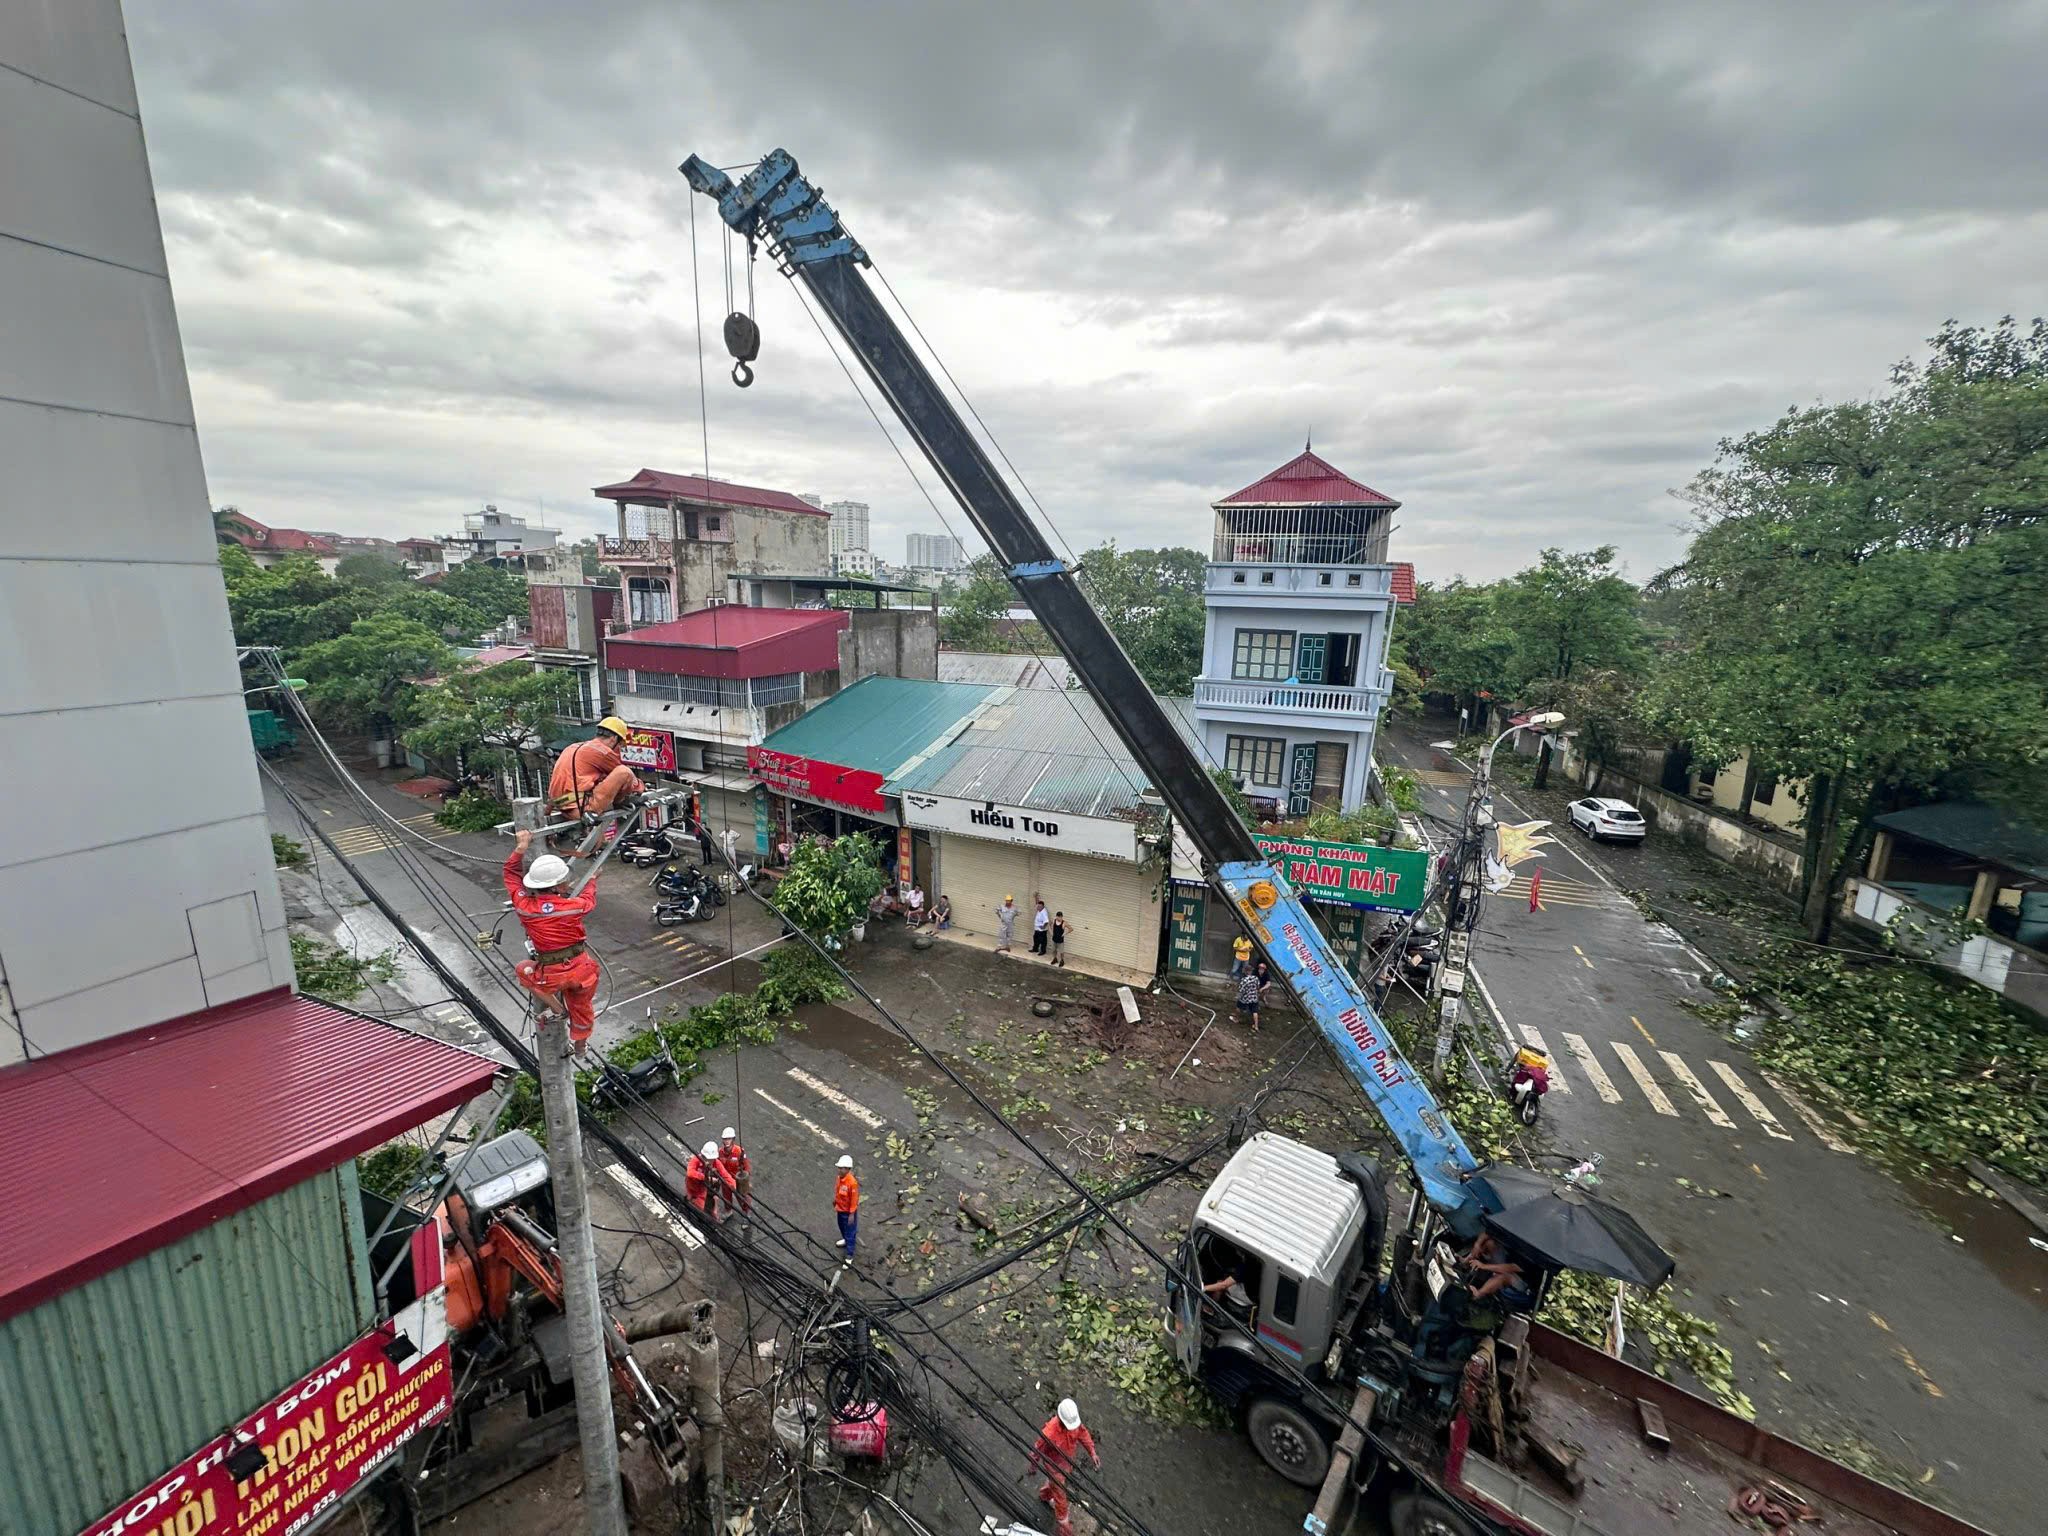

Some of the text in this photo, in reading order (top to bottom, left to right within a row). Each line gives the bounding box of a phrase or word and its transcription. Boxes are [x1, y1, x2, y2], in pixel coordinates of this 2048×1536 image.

[907, 794, 924, 803] Barber
[970, 808, 1014, 829] Hiếu
[1020, 816, 1059, 837] Top
[1257, 840, 1368, 863] PHÒNG KHÁM
[1289, 858, 1344, 888] HÀM
[1348, 866, 1401, 898] MẶT
[1183, 904, 1194, 916] TƯ
[1177, 955, 1192, 970] PHÍ
[335, 1361, 387, 1423] GÓI
[237, 1483, 280, 1528] LÀM
[284, 1444, 332, 1489] TRÁP
[336, 1406, 381, 1451] RỒNG
[283, 1467, 330, 1515] NHẬT
[335, 1437, 368, 1472] VĂN
[370, 1396, 420, 1445] PHÒNG
[312, 1489, 337, 1516] 233
